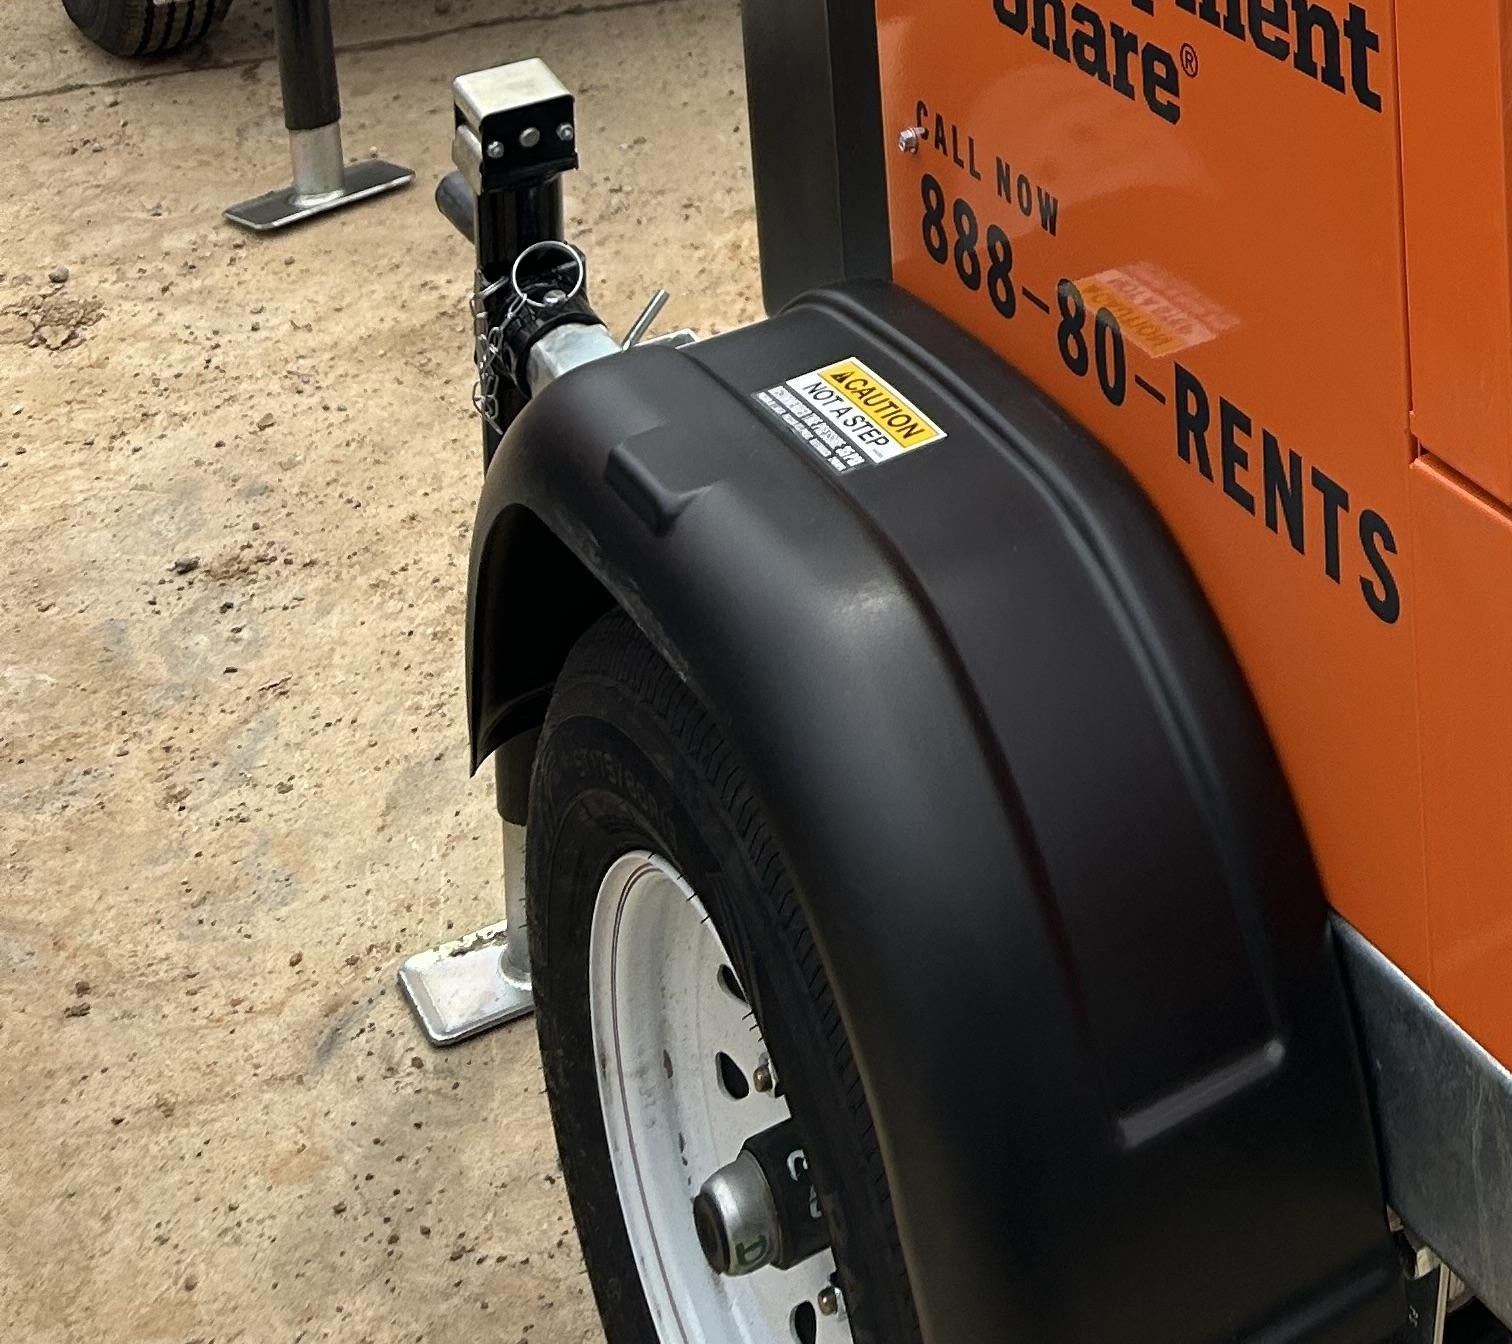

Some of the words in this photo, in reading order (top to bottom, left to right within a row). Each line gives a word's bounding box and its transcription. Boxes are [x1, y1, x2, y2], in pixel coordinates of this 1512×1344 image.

[916, 101, 981, 182] CALL
[996, 156, 1059, 237] NOW
[803, 381, 844, 407] NOT
[837, 405, 850, 419] A
[844, 413, 889, 448] STEP
[844, 378, 926, 439] CAUTION
[920, 173, 1400, 624] 888-80-RENTS
